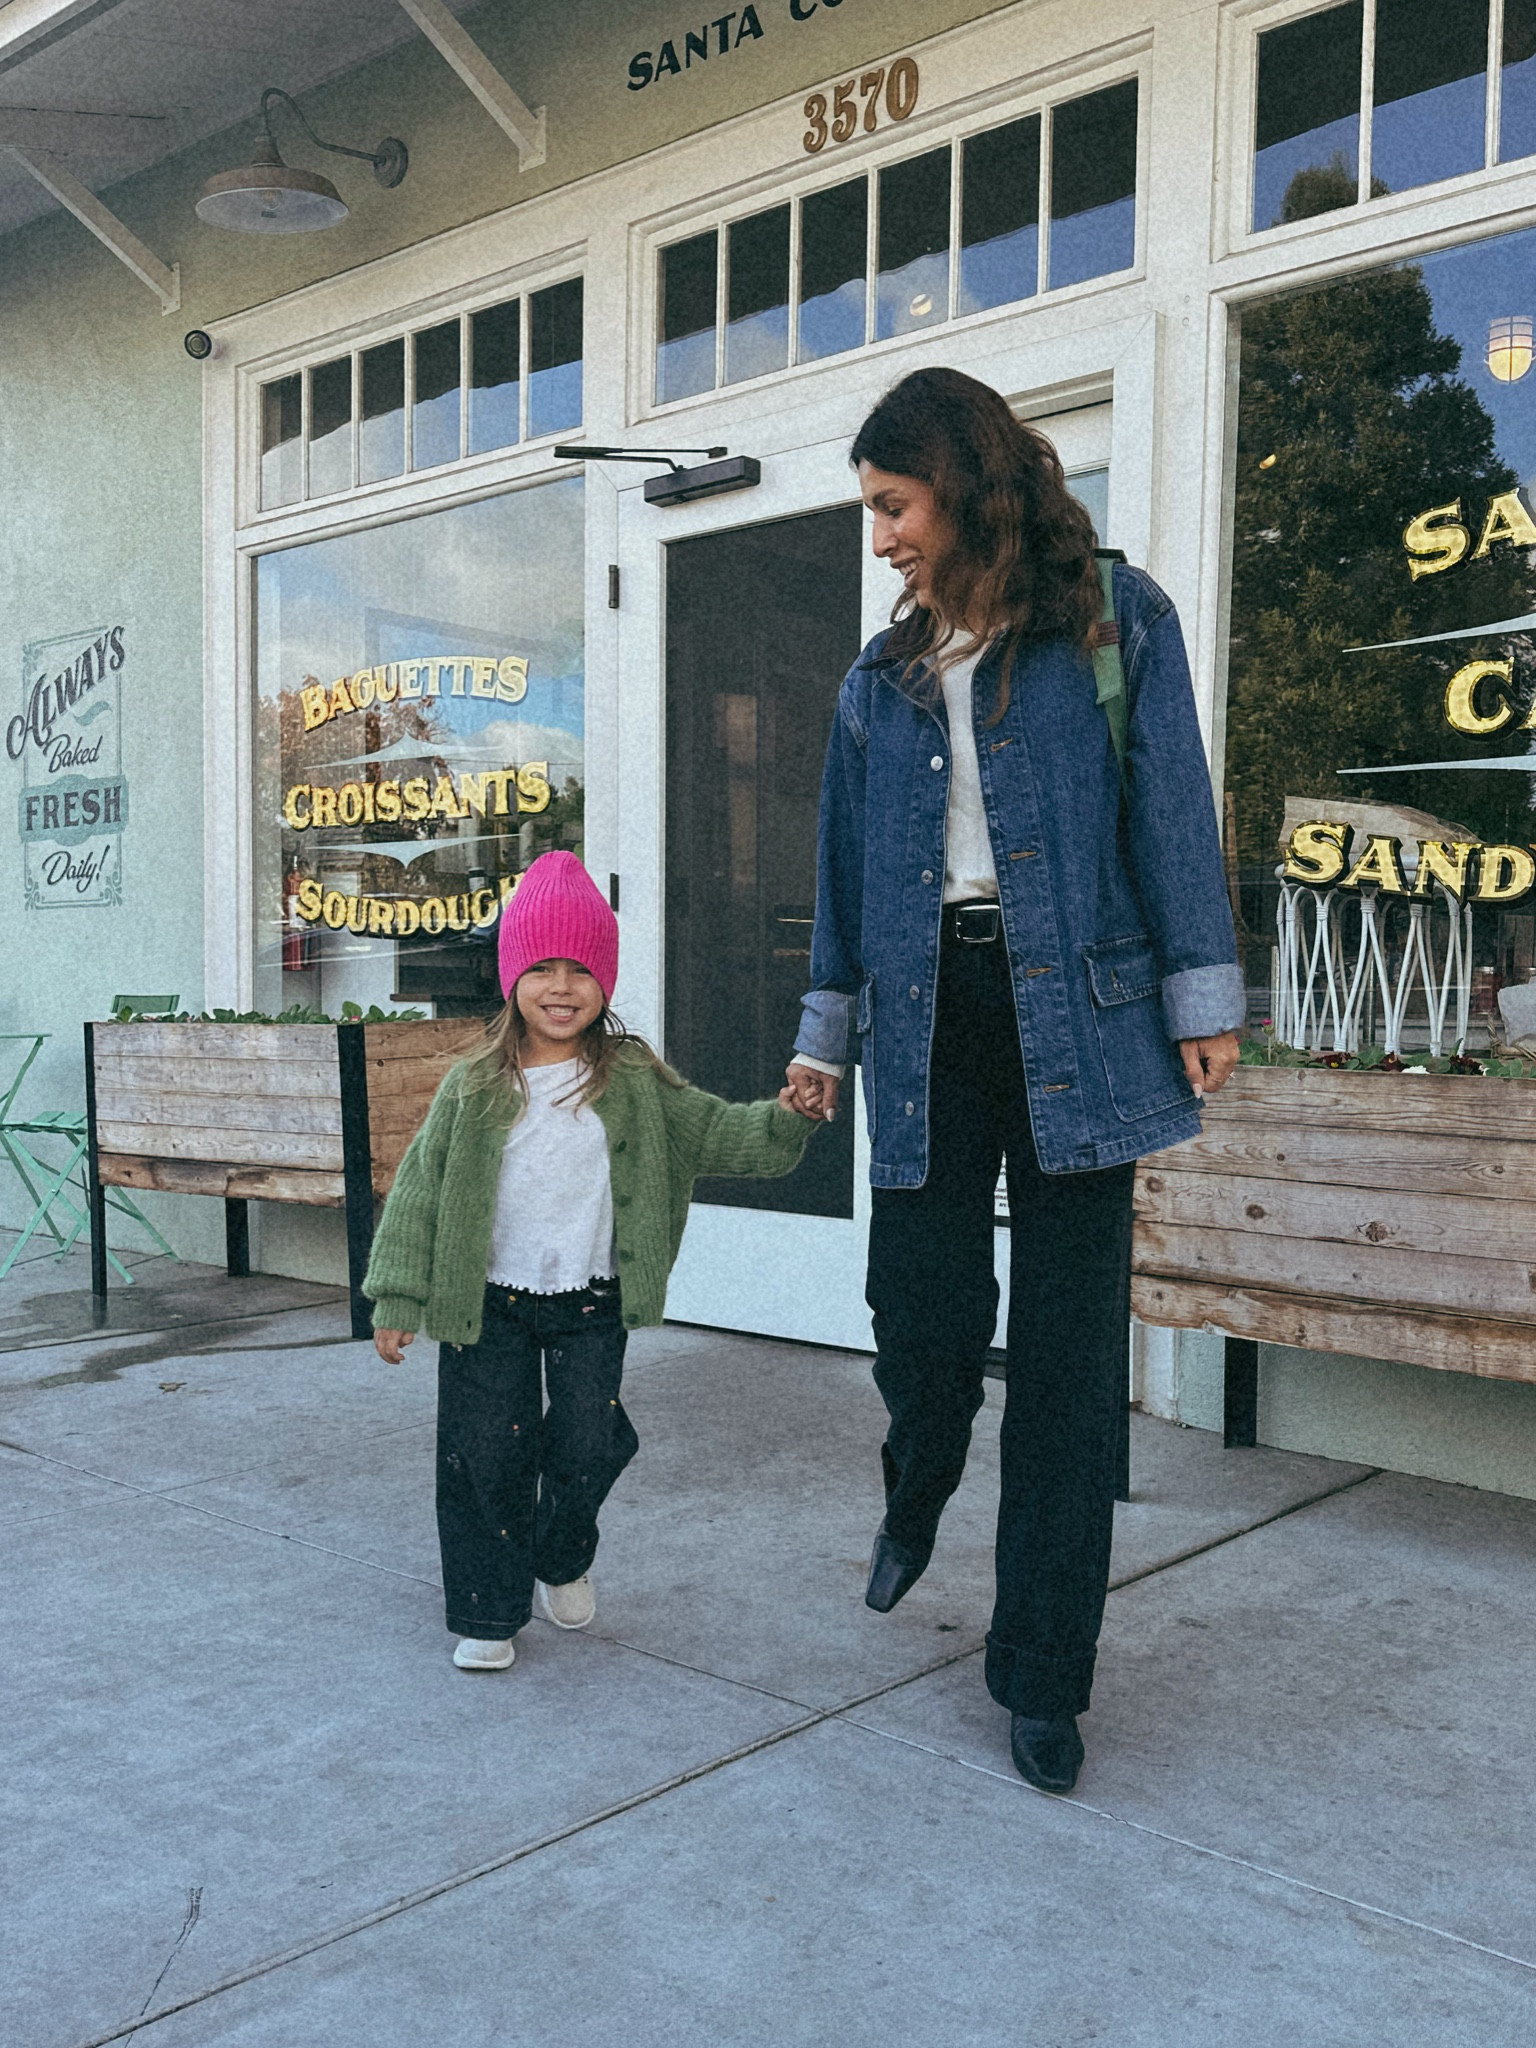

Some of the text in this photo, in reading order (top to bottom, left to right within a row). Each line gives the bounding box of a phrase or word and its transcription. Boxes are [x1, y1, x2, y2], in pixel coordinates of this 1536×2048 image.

[627, 0, 843, 91] SANTA C
[803, 57, 919, 153] 3570
[6, 625, 125, 760] ALWAYS
[300, 655, 529, 732] BAGUETTES
[1443, 656, 1536, 736] C
[45, 733, 103, 774] Baked
[24, 785, 122, 832] FRESH
[284, 761, 552, 831] CROISSANTS
[42, 844, 111, 894] Daily!
[1282, 820, 1536, 905] SAND
